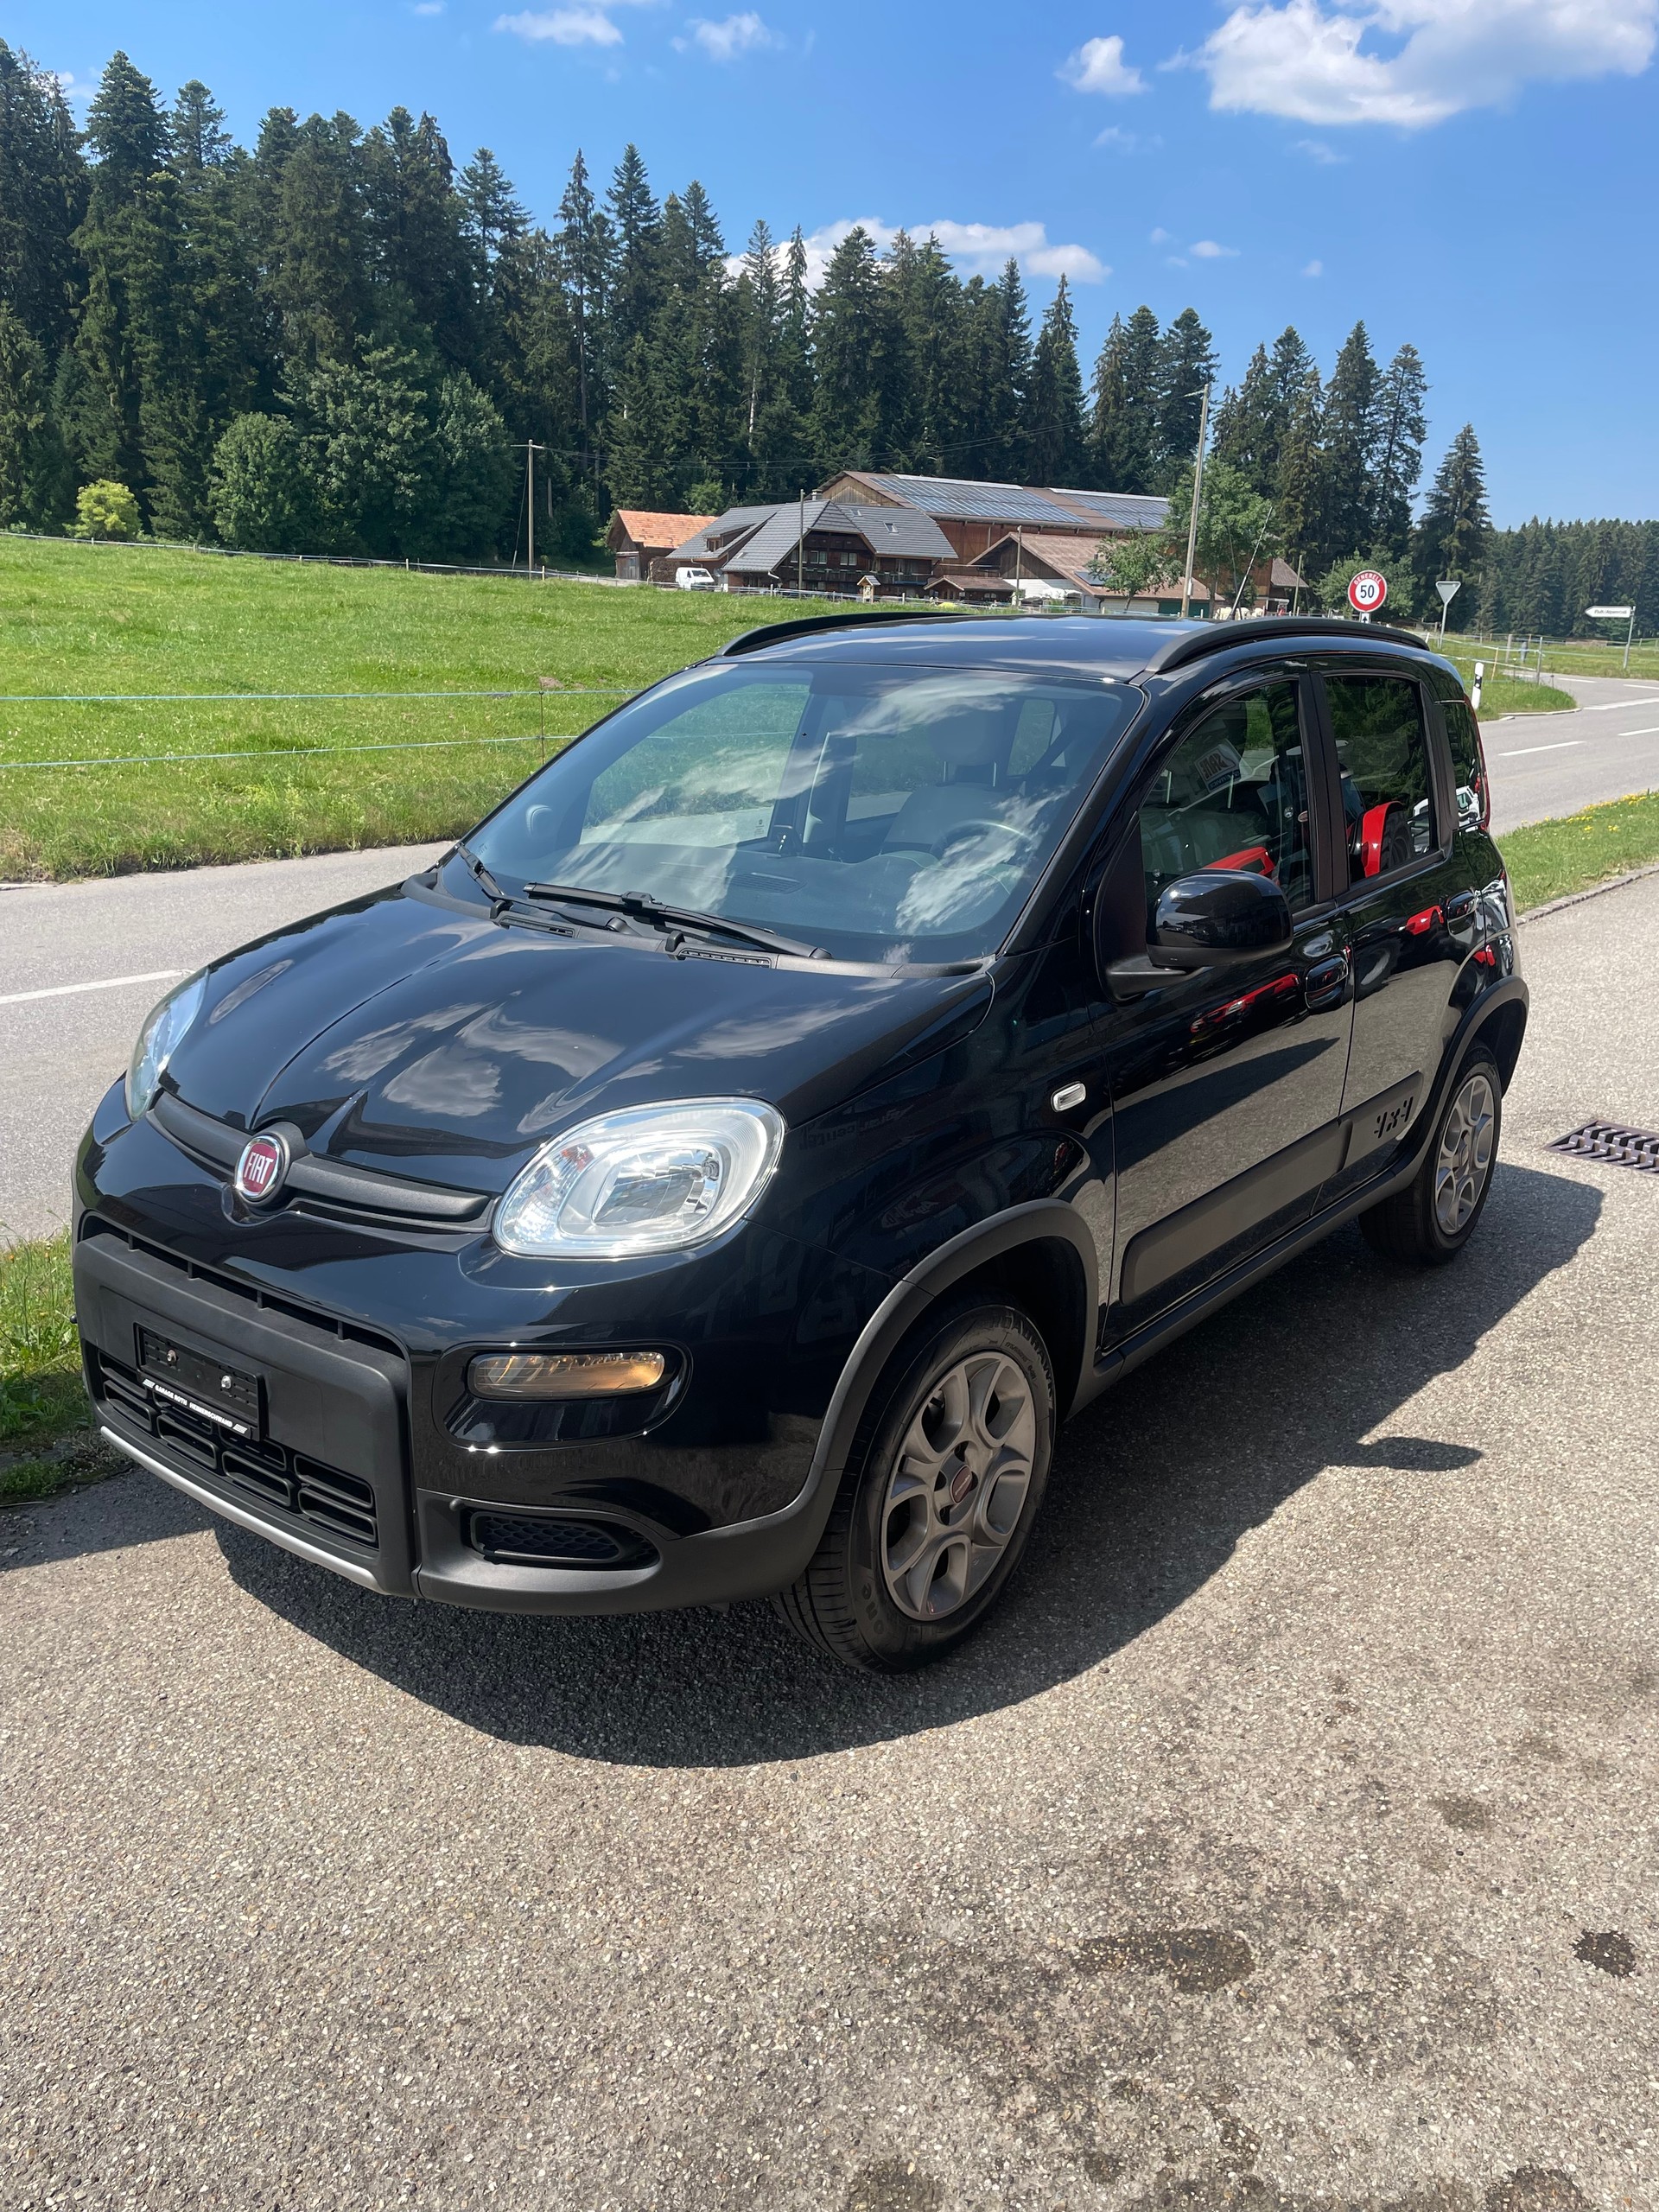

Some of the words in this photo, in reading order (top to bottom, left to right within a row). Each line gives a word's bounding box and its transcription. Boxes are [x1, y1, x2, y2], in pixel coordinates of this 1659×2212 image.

[1353, 573, 1382, 585] GENERELL
[1360, 585, 1375, 598] 50
[243, 1152, 275, 1185] FIAT
